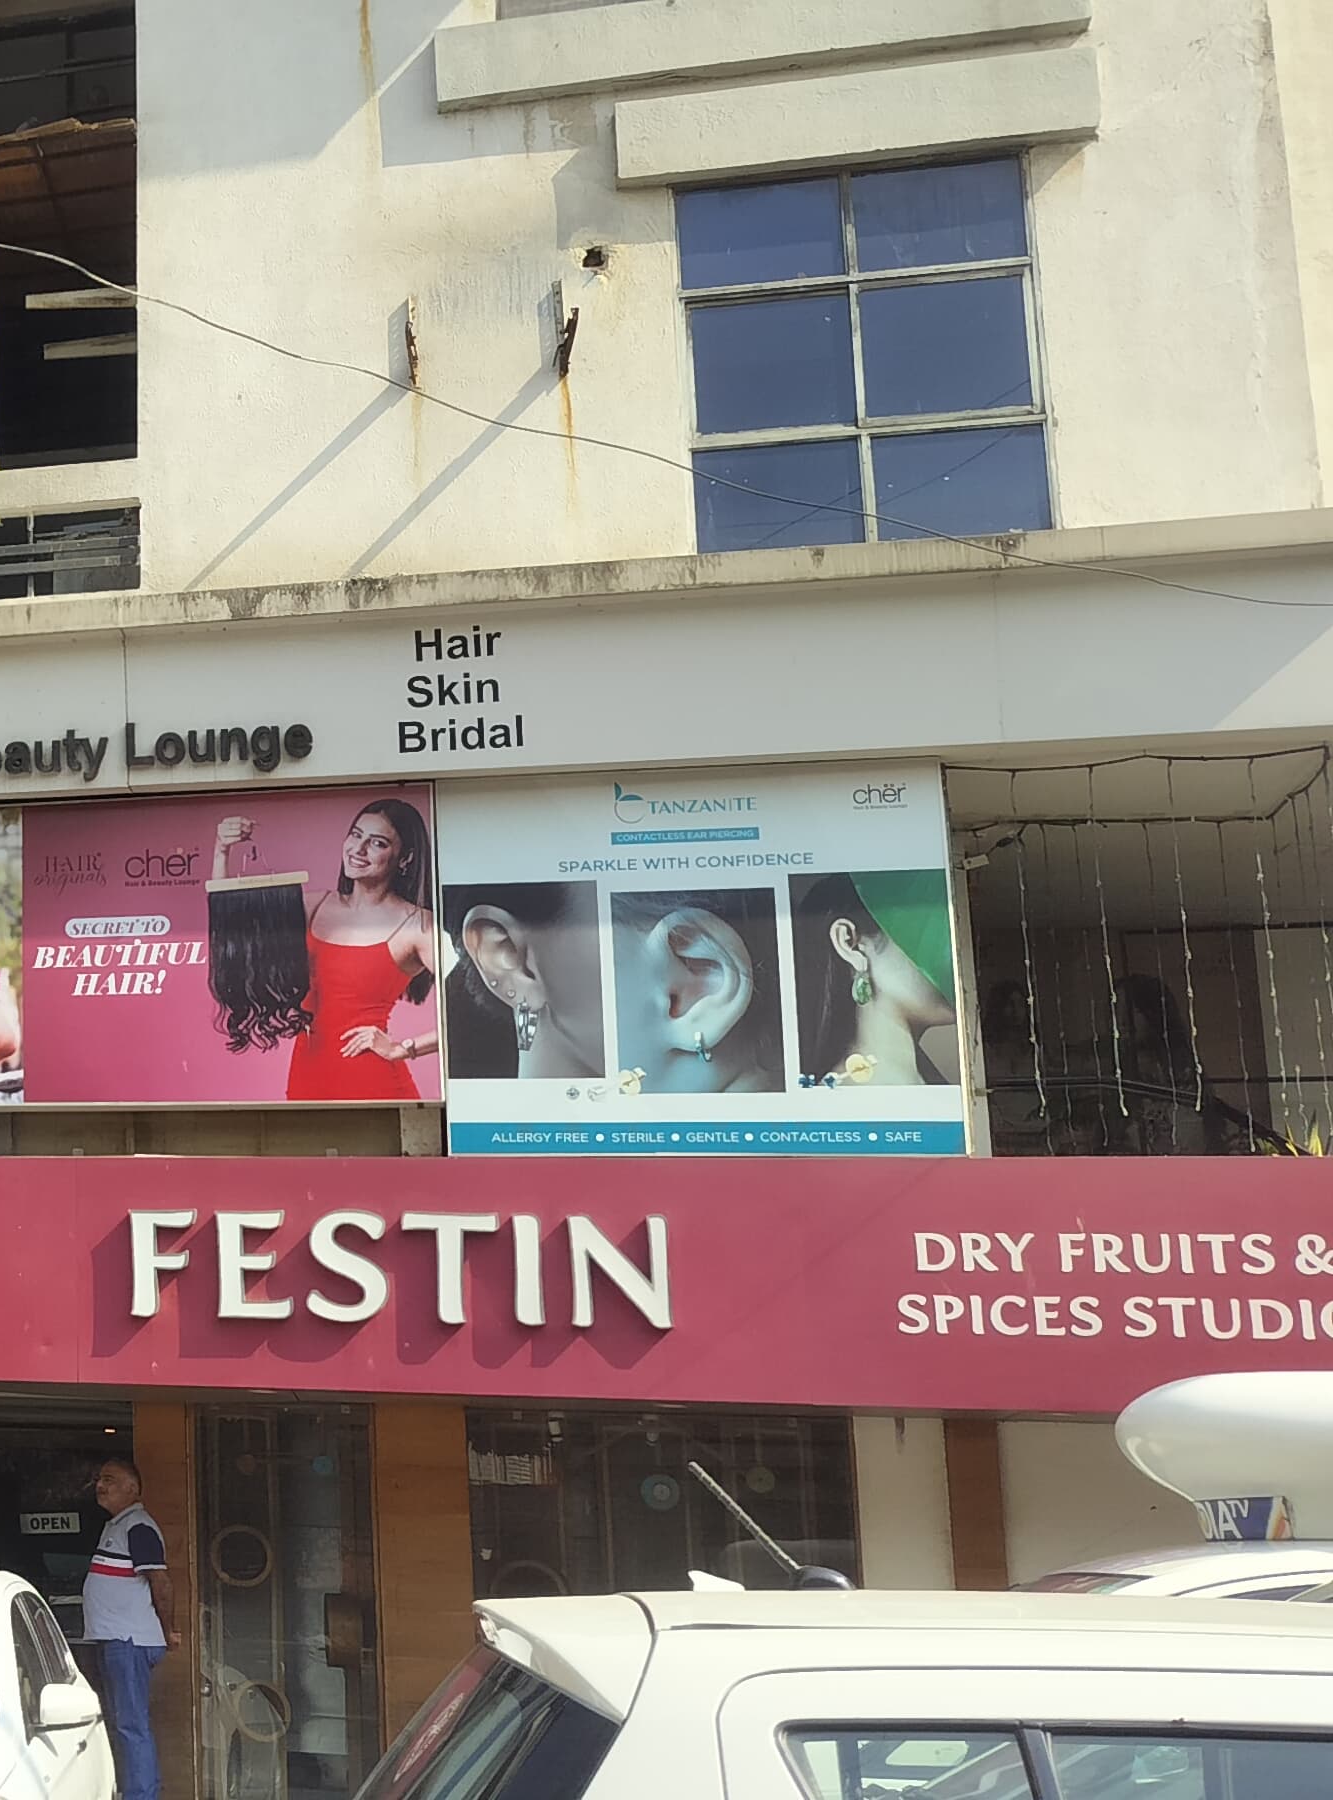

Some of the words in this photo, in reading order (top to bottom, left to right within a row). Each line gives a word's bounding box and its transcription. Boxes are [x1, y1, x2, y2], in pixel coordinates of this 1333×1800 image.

[414, 625, 501, 662] Hair
[407, 672, 500, 708] Skin
[124, 722, 314, 772] Lounge
[398, 715, 523, 753] Bridal
[647, 797, 757, 815] TANZANITE
[615, 832, 685, 843] CONTACTLESS
[686, 831, 708, 840] EAR
[709, 829, 754, 839] PIERCING
[45, 853, 102, 873] HAIR
[558, 858, 637, 874] SPARKLE
[642, 856, 689, 871] WITH
[695, 852, 814, 869] CONFIDENCE
[71, 919, 139, 935] SECRET
[141, 918, 166, 934] TO
[32, 938, 206, 969] BEAUTIFUL
[71, 969, 167, 996] HAIR!
[491, 1132, 551, 1144] ALLERGY
[555, 1132, 589, 1143] FREE
[612, 1132, 666, 1143] STERILE
[686, 1131, 739, 1143] GENTLE
[760, 1131, 862, 1143] CONTACTLESS
[884, 1131, 922, 1143] SAFE
[914, 1232, 1034, 1273] DRY
[1058, 1232, 1275, 1275] FRUITS
[1294, 1233, 1333, 1275] &
[130, 1209, 673, 1329] FESTIN
[897, 1294, 1102, 1337] SPICES
[1226, 1499, 1249, 1518] TV
[30, 1516, 71, 1530] OPEN
